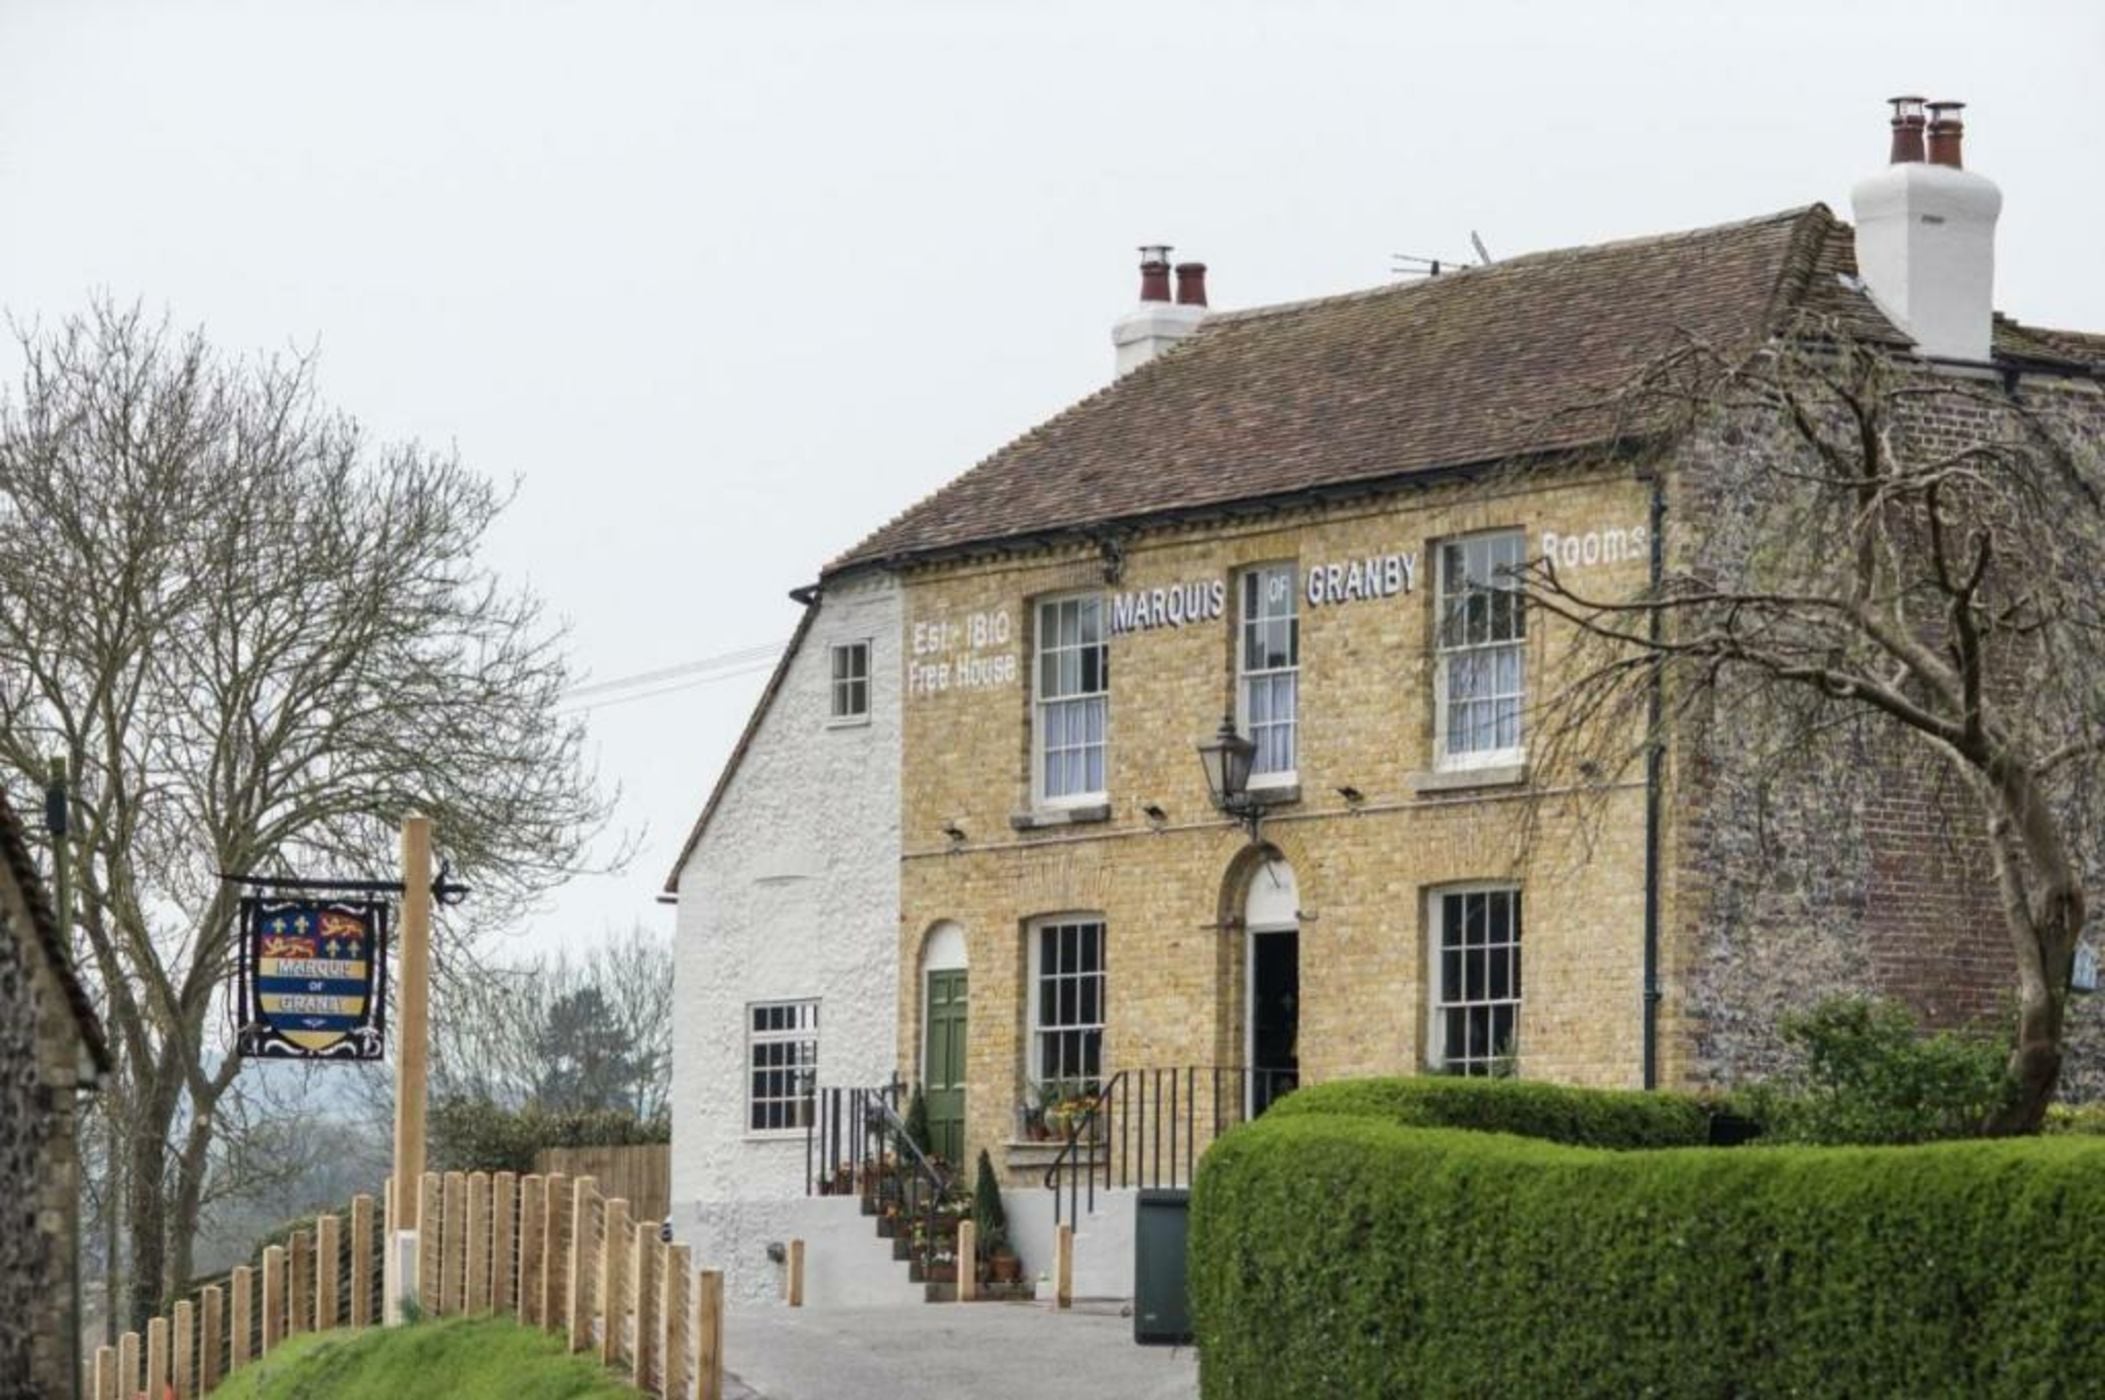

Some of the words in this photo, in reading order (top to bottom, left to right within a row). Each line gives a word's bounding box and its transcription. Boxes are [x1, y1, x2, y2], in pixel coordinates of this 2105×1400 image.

[1542, 526, 1646, 570] Rooms
[1111, 578, 1225, 634] MARQUIS
[1268, 574, 1291, 603] OF
[1307, 552, 1416, 608] GRANBY
[908, 660, 950, 694] Free
[956, 654, 1016, 687] House
[279, 994, 345, 1013] GRANY
